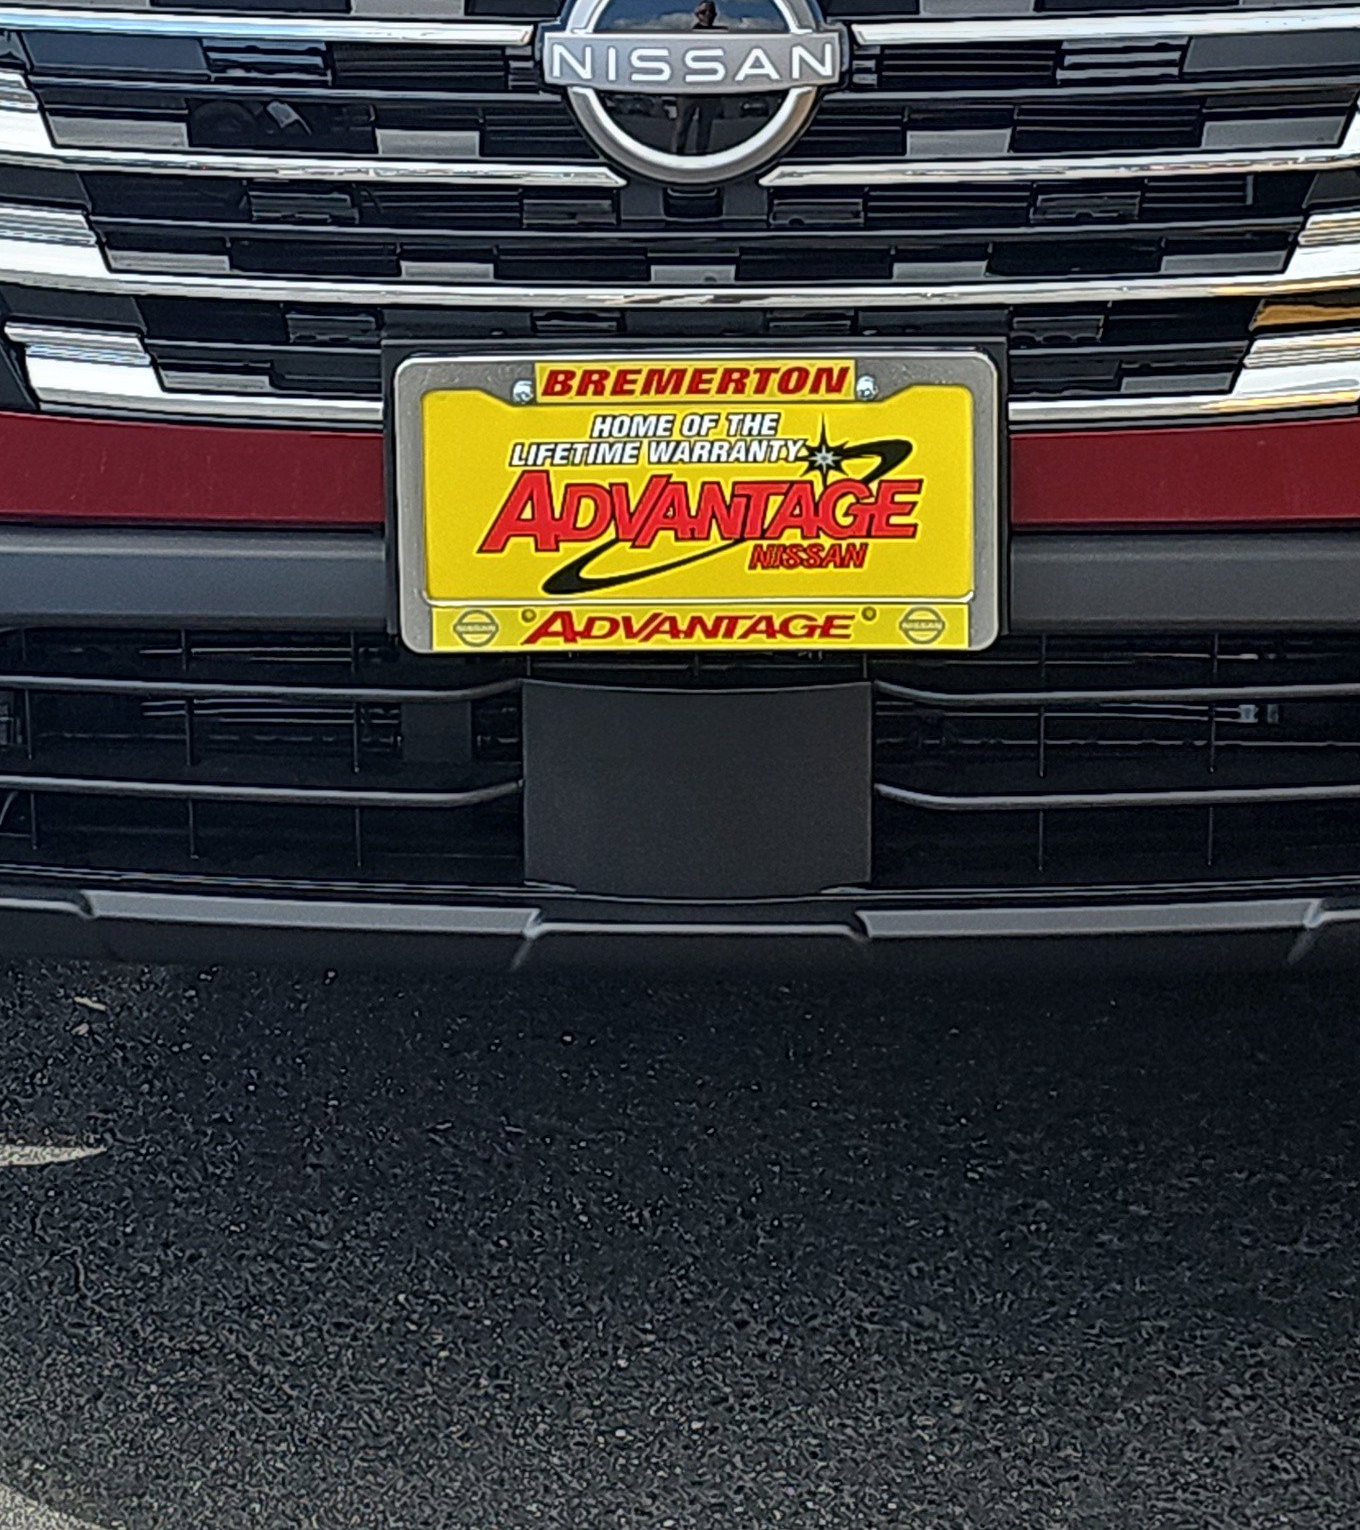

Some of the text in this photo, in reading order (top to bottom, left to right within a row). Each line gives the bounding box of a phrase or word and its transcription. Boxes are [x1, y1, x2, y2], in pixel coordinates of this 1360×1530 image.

[551, 42, 834, 83] NISSAN
[541, 366, 851, 397] BREMERTON
[590, 412, 781, 439] HOME OF THE
[508, 438, 808, 467] LIFETIME WARRANTY
[477, 469, 924, 553] ADVANTAGE
[747, 542, 868, 570] NISSAN
[521, 610, 855, 646] ADVANTAGE
